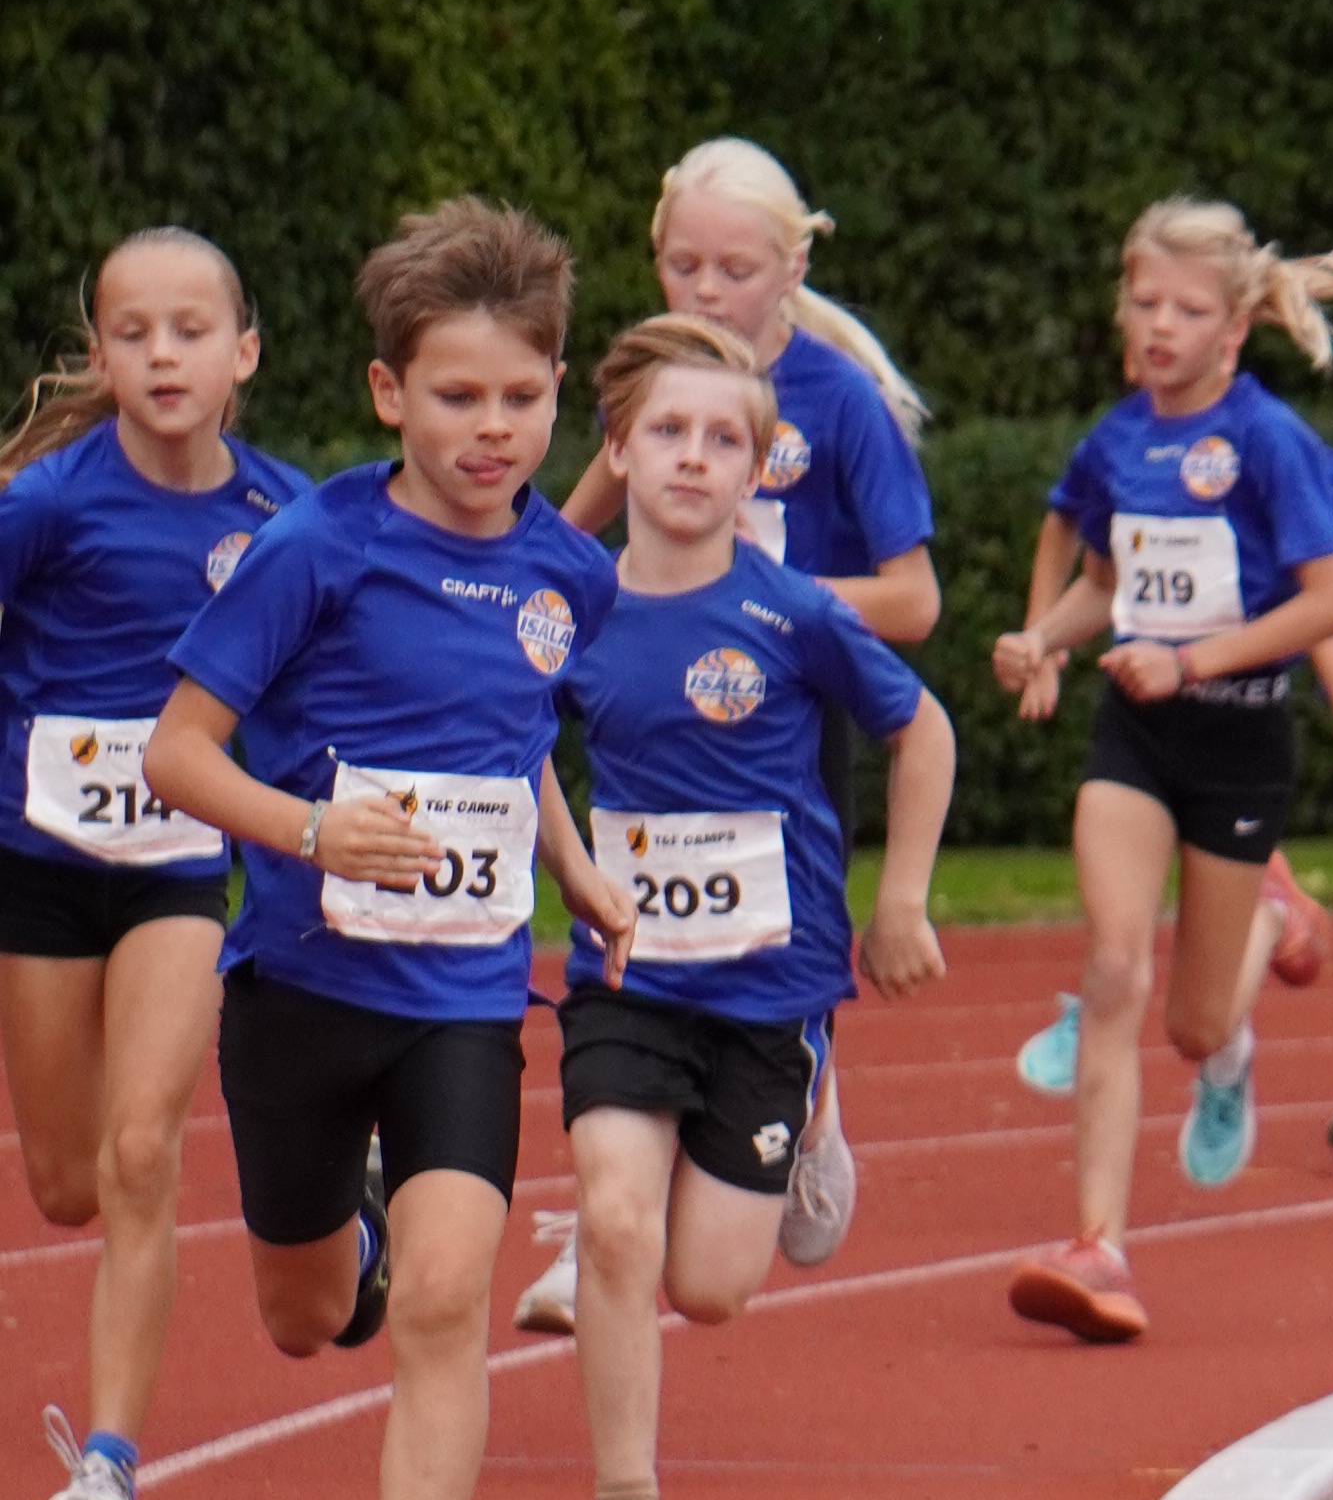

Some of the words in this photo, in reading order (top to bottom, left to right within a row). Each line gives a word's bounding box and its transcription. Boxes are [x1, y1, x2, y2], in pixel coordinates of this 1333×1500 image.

[442, 578, 502, 603] CRAFT
[1135, 567, 1194, 605] 219
[519, 614, 573, 649] ISALA
[688, 672, 764, 695] ISALA
[78, 782, 170, 825] 214
[457, 800, 510, 816] CAMPS
[375, 847, 501, 898] 03
[634, 872, 741, 918] 209
